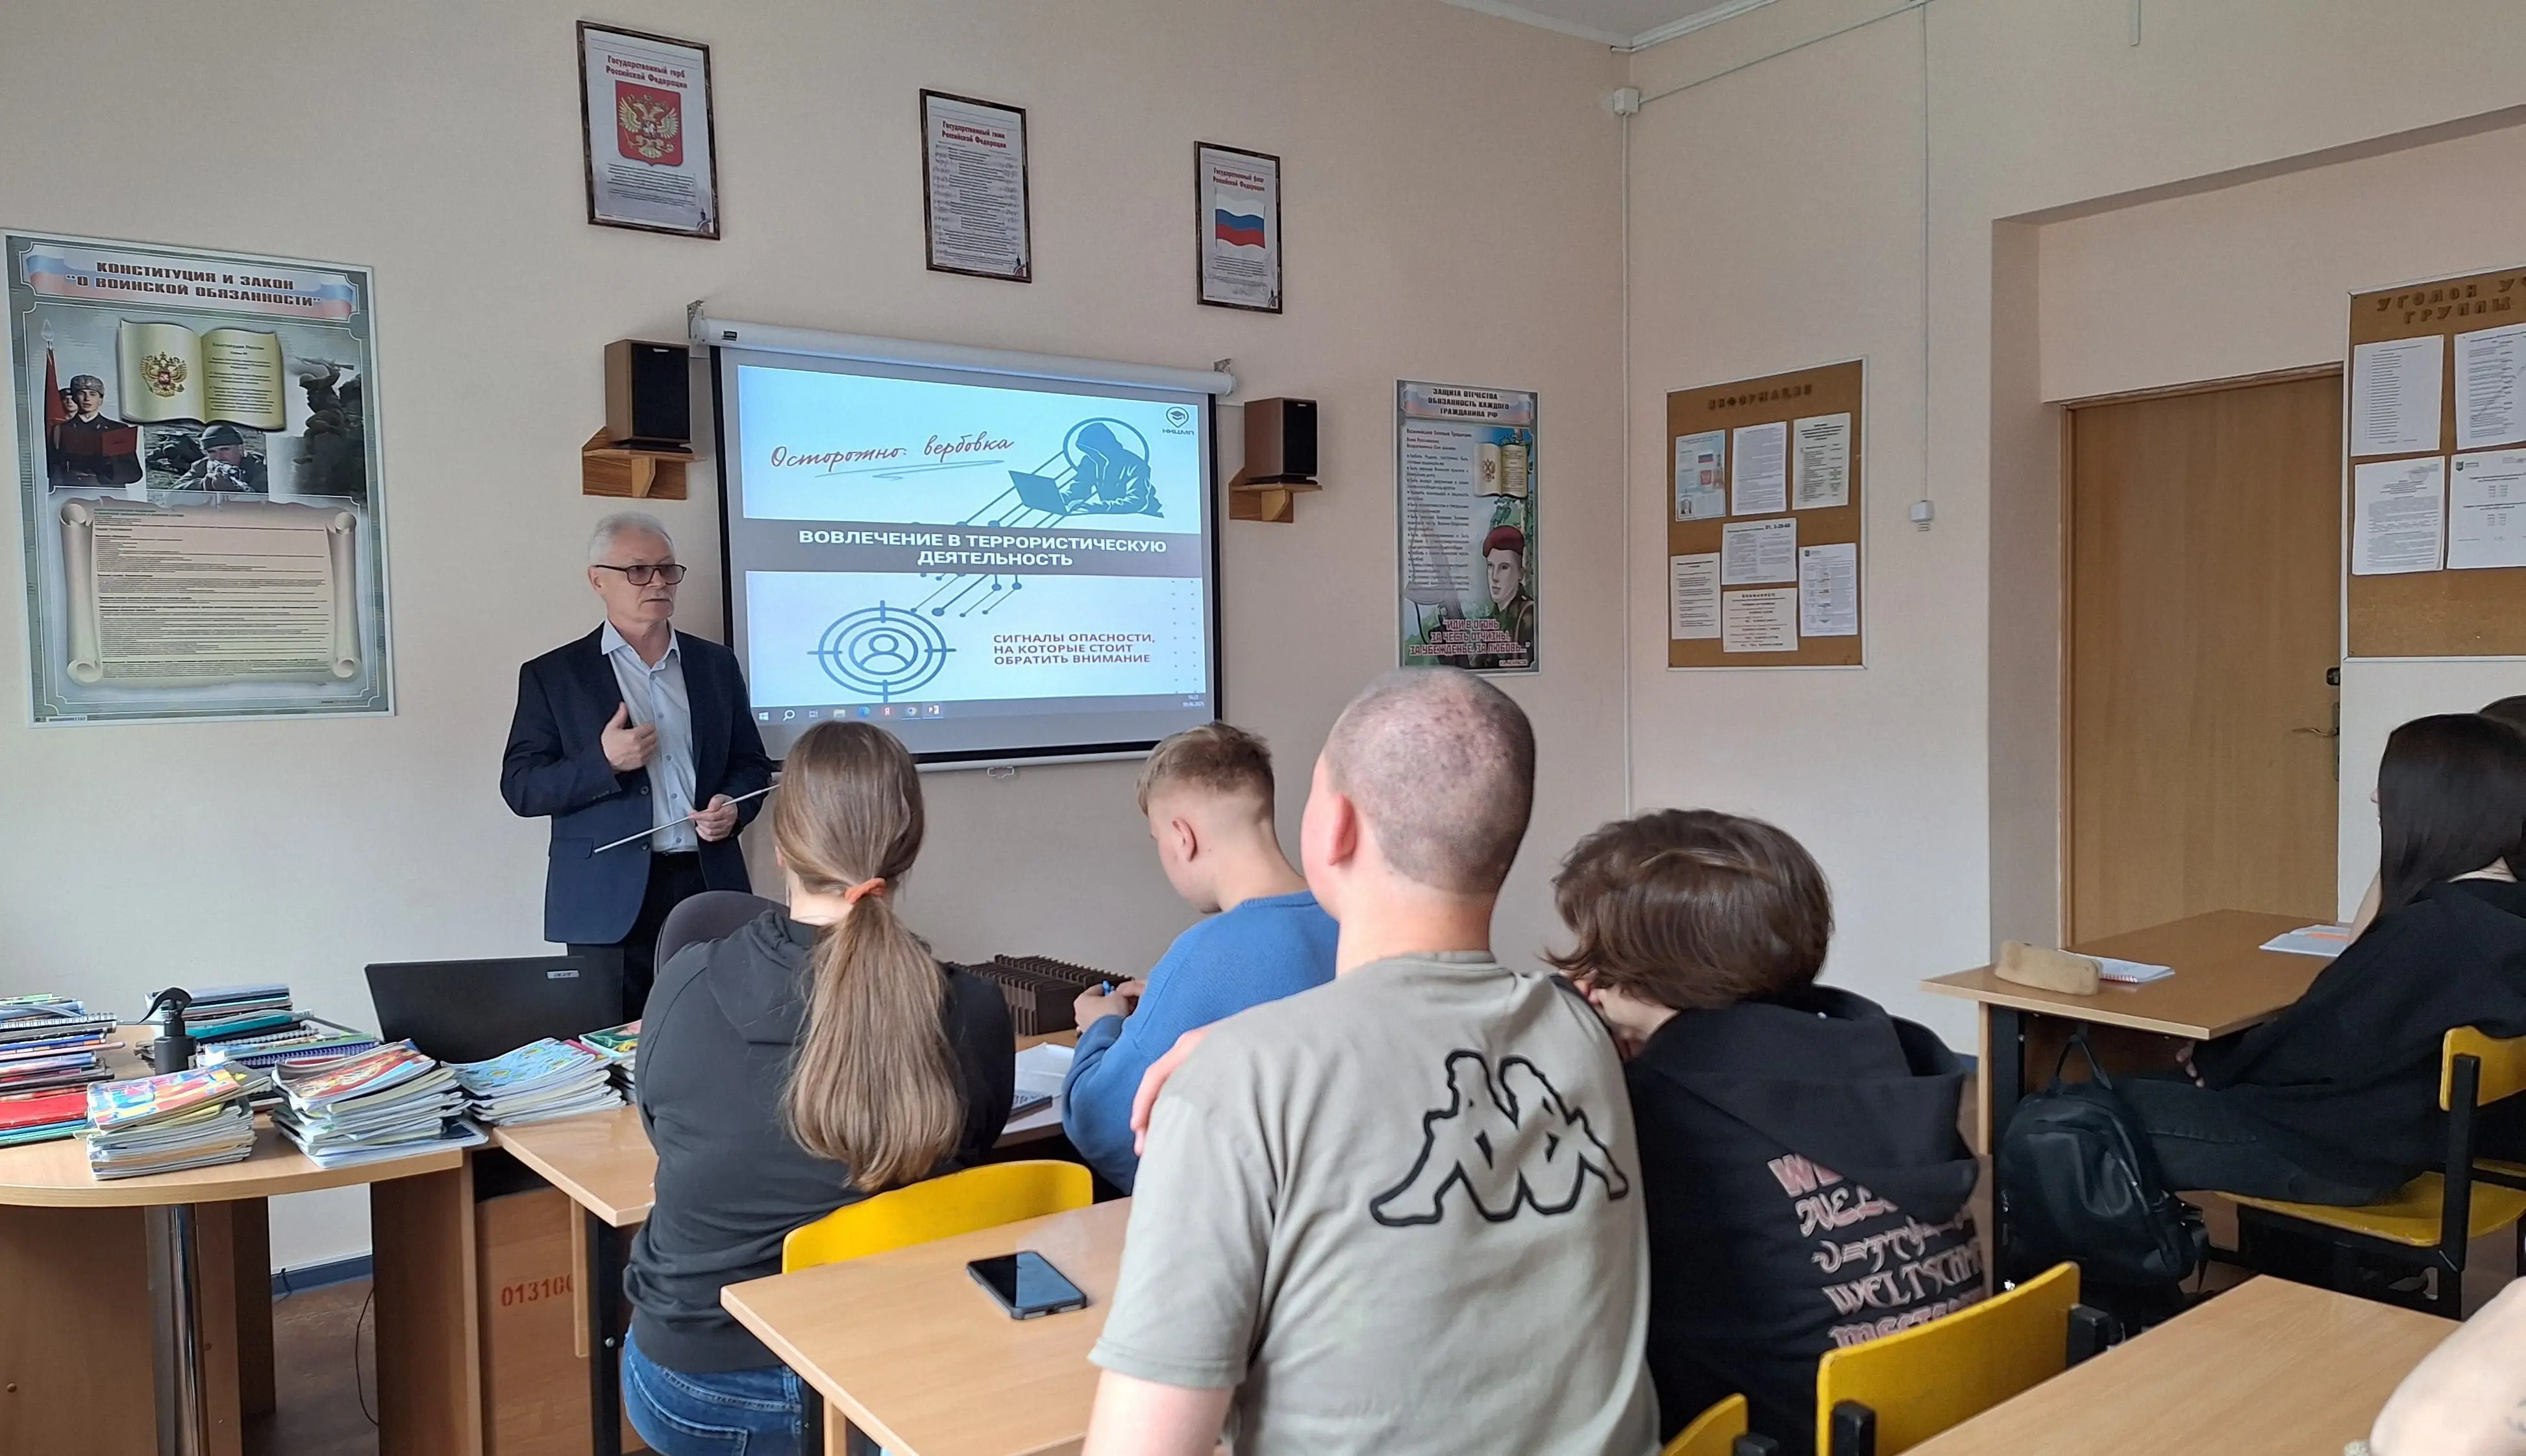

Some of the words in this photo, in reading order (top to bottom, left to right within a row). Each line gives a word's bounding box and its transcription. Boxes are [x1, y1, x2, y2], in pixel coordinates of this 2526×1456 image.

[608, 55, 667, 74] Государственный
[670, 69, 686, 79] герб
[606, 65, 645, 80] Российской
[648, 73, 687, 89] Федерации
[943, 121, 990, 136] Государственный
[941, 130, 973, 142] Российской
[97, 262, 216, 283] КОНСТИТУЦИЯ
[223, 273, 234, 284] И
[240, 276, 294, 290] ЗАКОН
[95, 277, 188, 295] ВОИНСКОЙ
[2377, 284, 2477, 312] УГОЛОК
[2405, 296, 2511, 324] ГРУППЫ
[1433, 388, 1461, 397] ЗАЩИТА
[1463, 391, 1498, 400] ОТЕЧЕСТВА
[1428, 397, 1476, 407] ОБЯЗАННОСТЬ
[1478, 401, 1509, 410] КАЖДОГО
[1441, 408, 1485, 417] ГРАЖДАНИНА
[924, 431, 1015, 463] вербовка
[799, 530, 944, 546] ВОВЛЕЧЕНИЕ
[948, 534, 961, 547] В
[965, 535, 1167, 552] ТЕРРОРИСТИЧЕСКУЮ
[917, 550, 1073, 565] ДЕЯТЕЛЬНОСТЬ
[1474, 620, 1499, 630] ОГОНЬ
[993, 634, 1064, 643] СИГНАЛЫ
[1069, 634, 1156, 643] ОПАСНОСТИ,
[1431, 633, 1442, 642] ЗА
[1443, 632, 1468, 641] ЧЕСТЬ
[994, 645, 1014, 654] НА
[1019, 645, 1085, 654] КОТОРЫЕ
[1089, 644, 1133, 652] СТОИТ
[1409, 645, 1420, 655] ЗА
[1476, 643, 1487, 653] ЗА
[994, 655, 1069, 665] ОБРАТИТЬ
[1072, 654, 1150, 663] ВНИМАНИЕ
